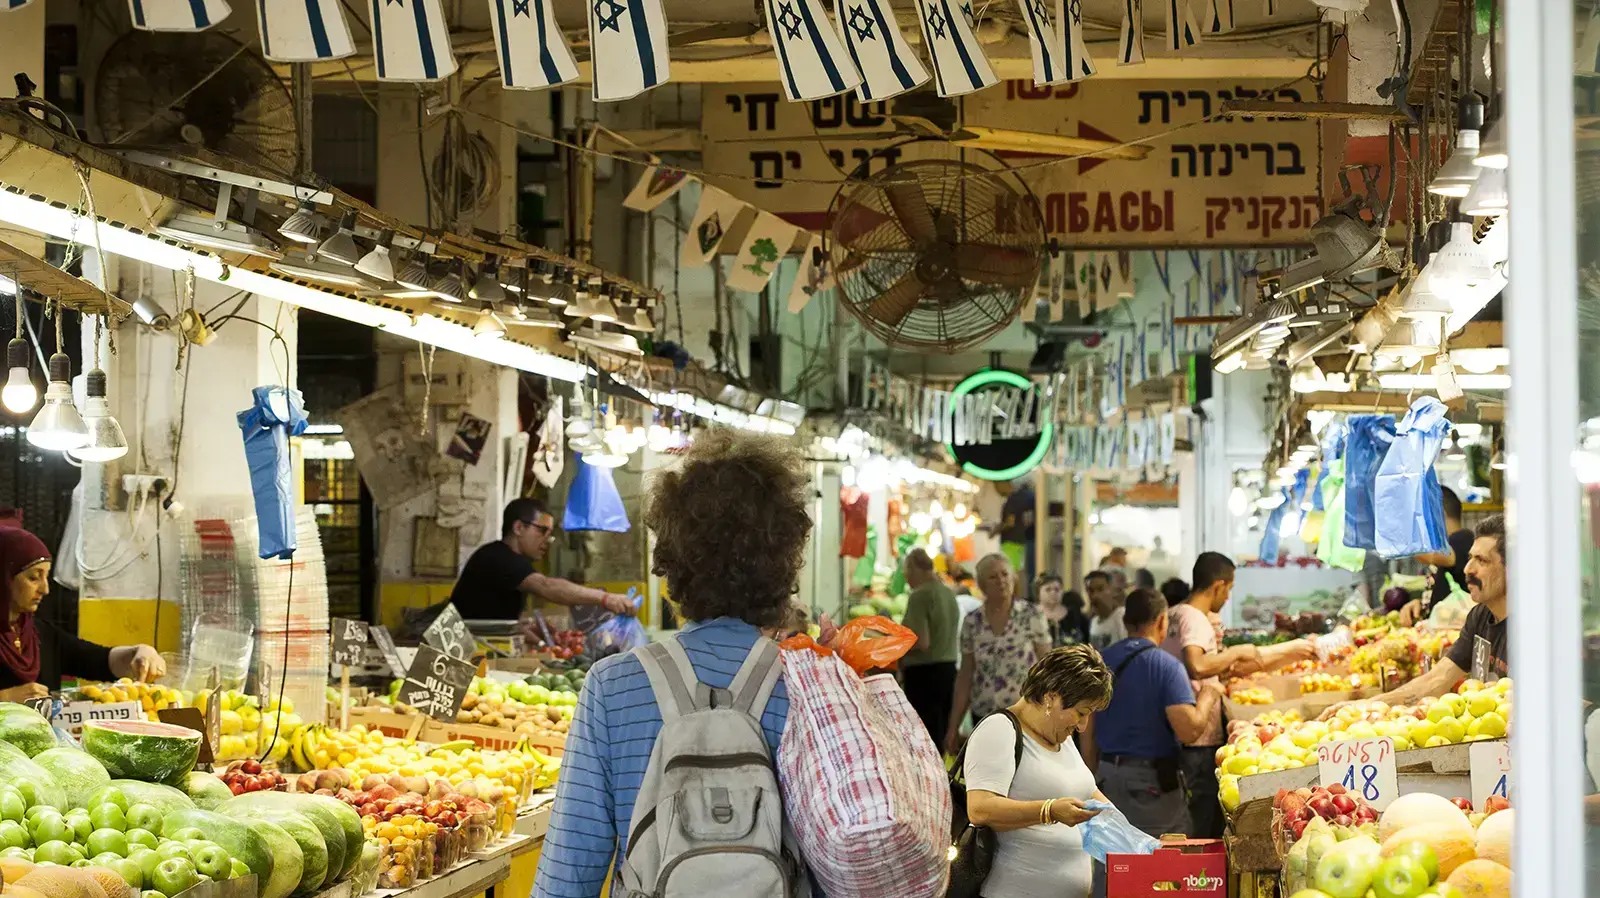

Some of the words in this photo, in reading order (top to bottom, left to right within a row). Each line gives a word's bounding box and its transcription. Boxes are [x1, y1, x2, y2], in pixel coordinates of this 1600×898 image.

[725, 93, 780, 131] חי
[749, 151, 802, 189] ים
[1170, 141, 1306, 178] ברינזה
[994, 189, 1175, 234] КОЛБАСЫ
[1205, 196, 1324, 238] הנקניק
[433, 654, 449, 676] 6
[406, 676, 455, 699] בננות
[89, 707, 131, 720] פירות
[1341, 763, 1381, 802] 18
[1182, 873, 1224, 891] מייסטר
